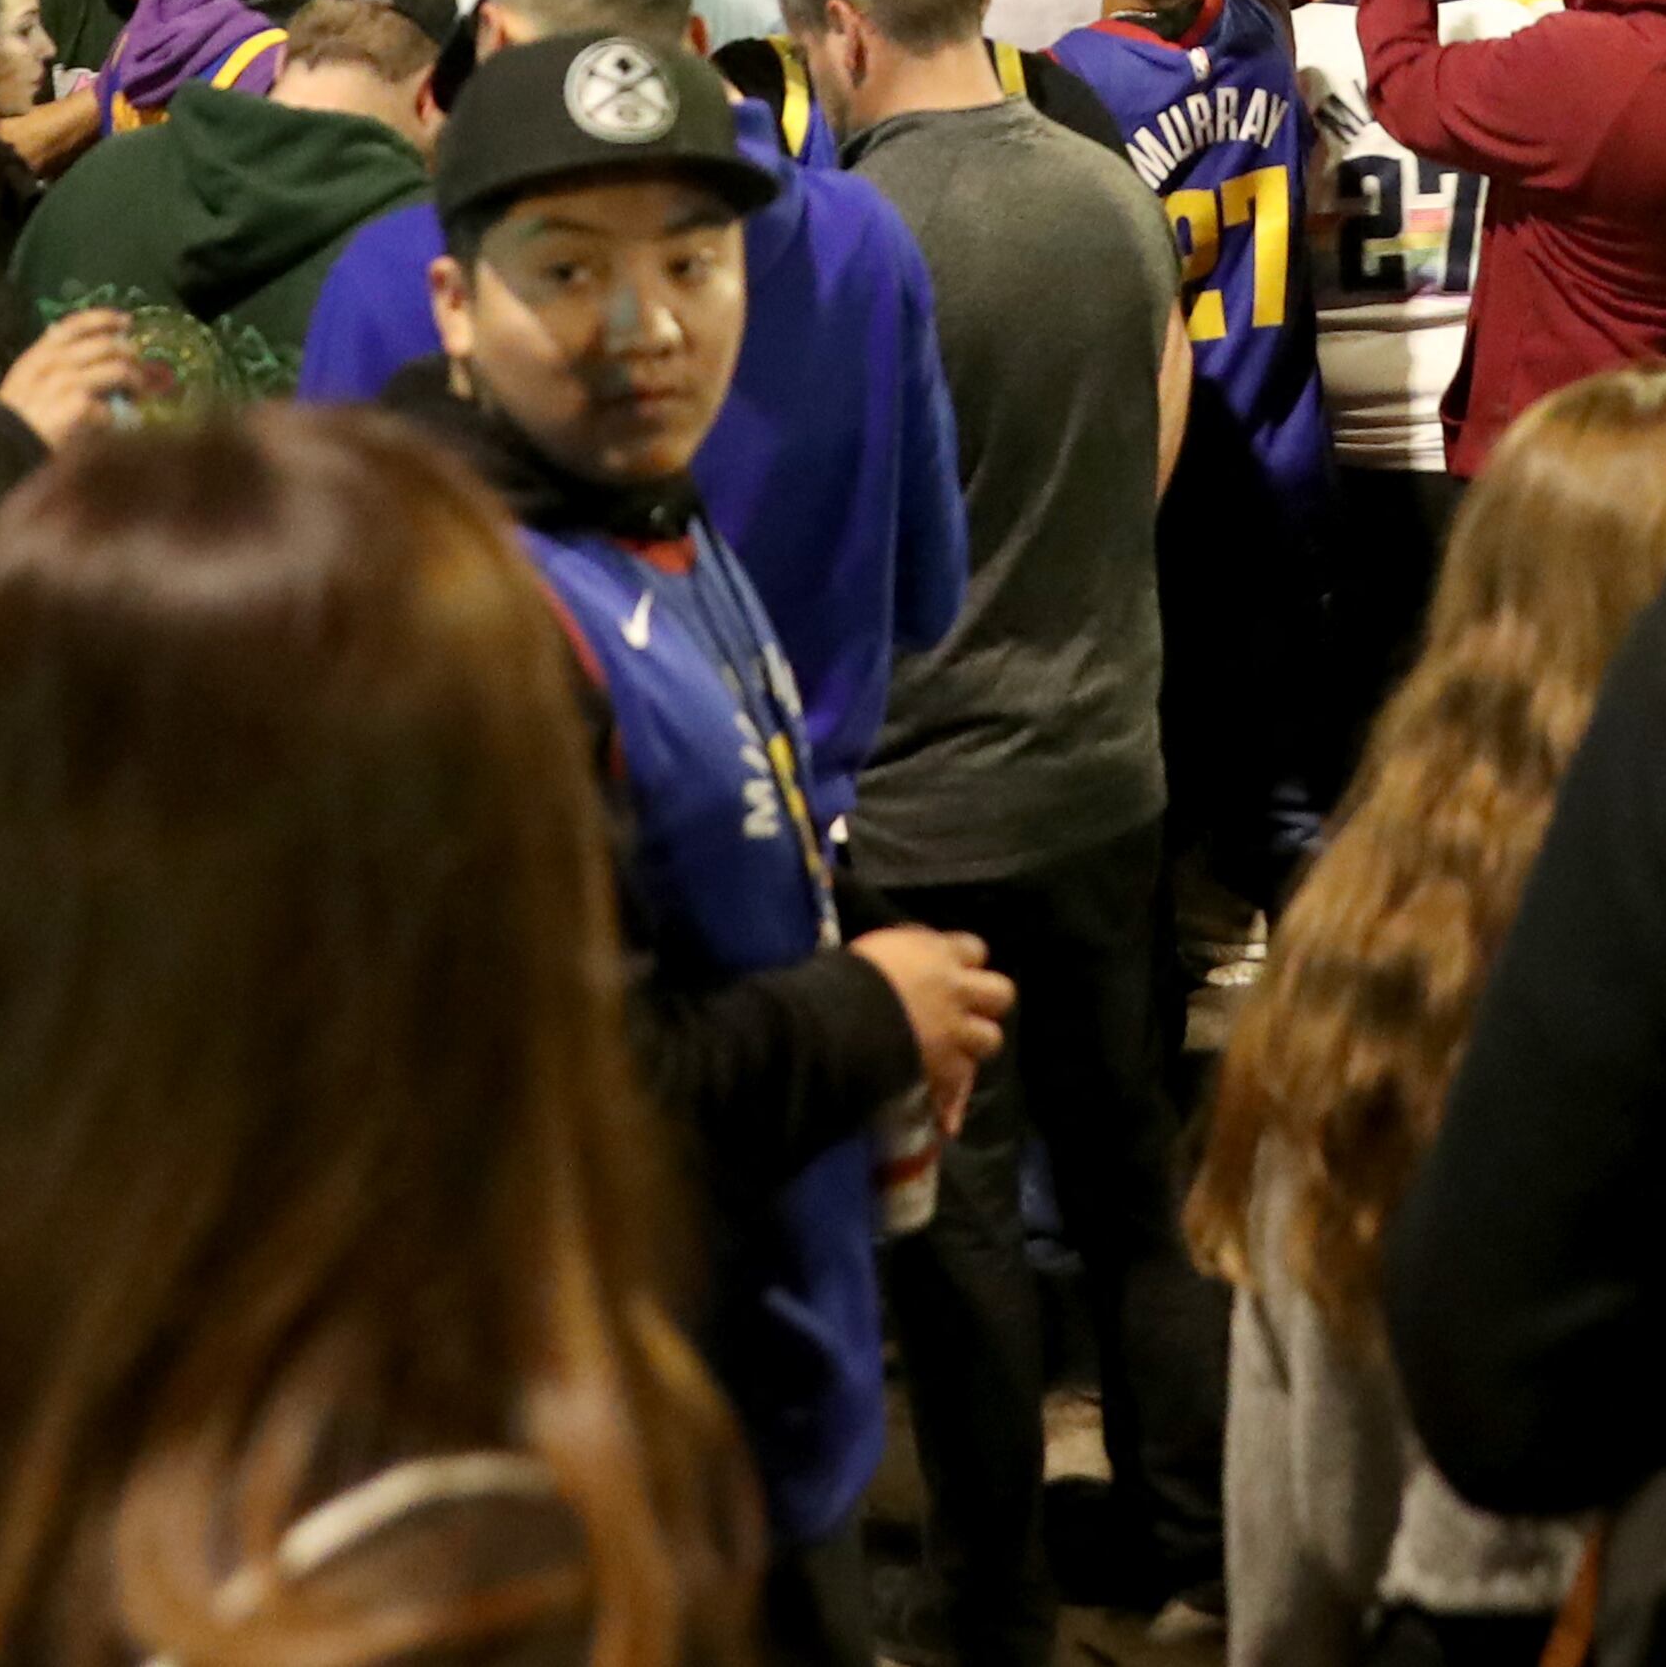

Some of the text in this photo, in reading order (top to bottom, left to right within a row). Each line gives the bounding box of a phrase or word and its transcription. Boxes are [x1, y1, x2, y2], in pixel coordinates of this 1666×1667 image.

[1126, 85, 1289, 191] MURRAY
[1165, 164, 1290, 342] 27
[1337, 155, 1482, 294] 27
